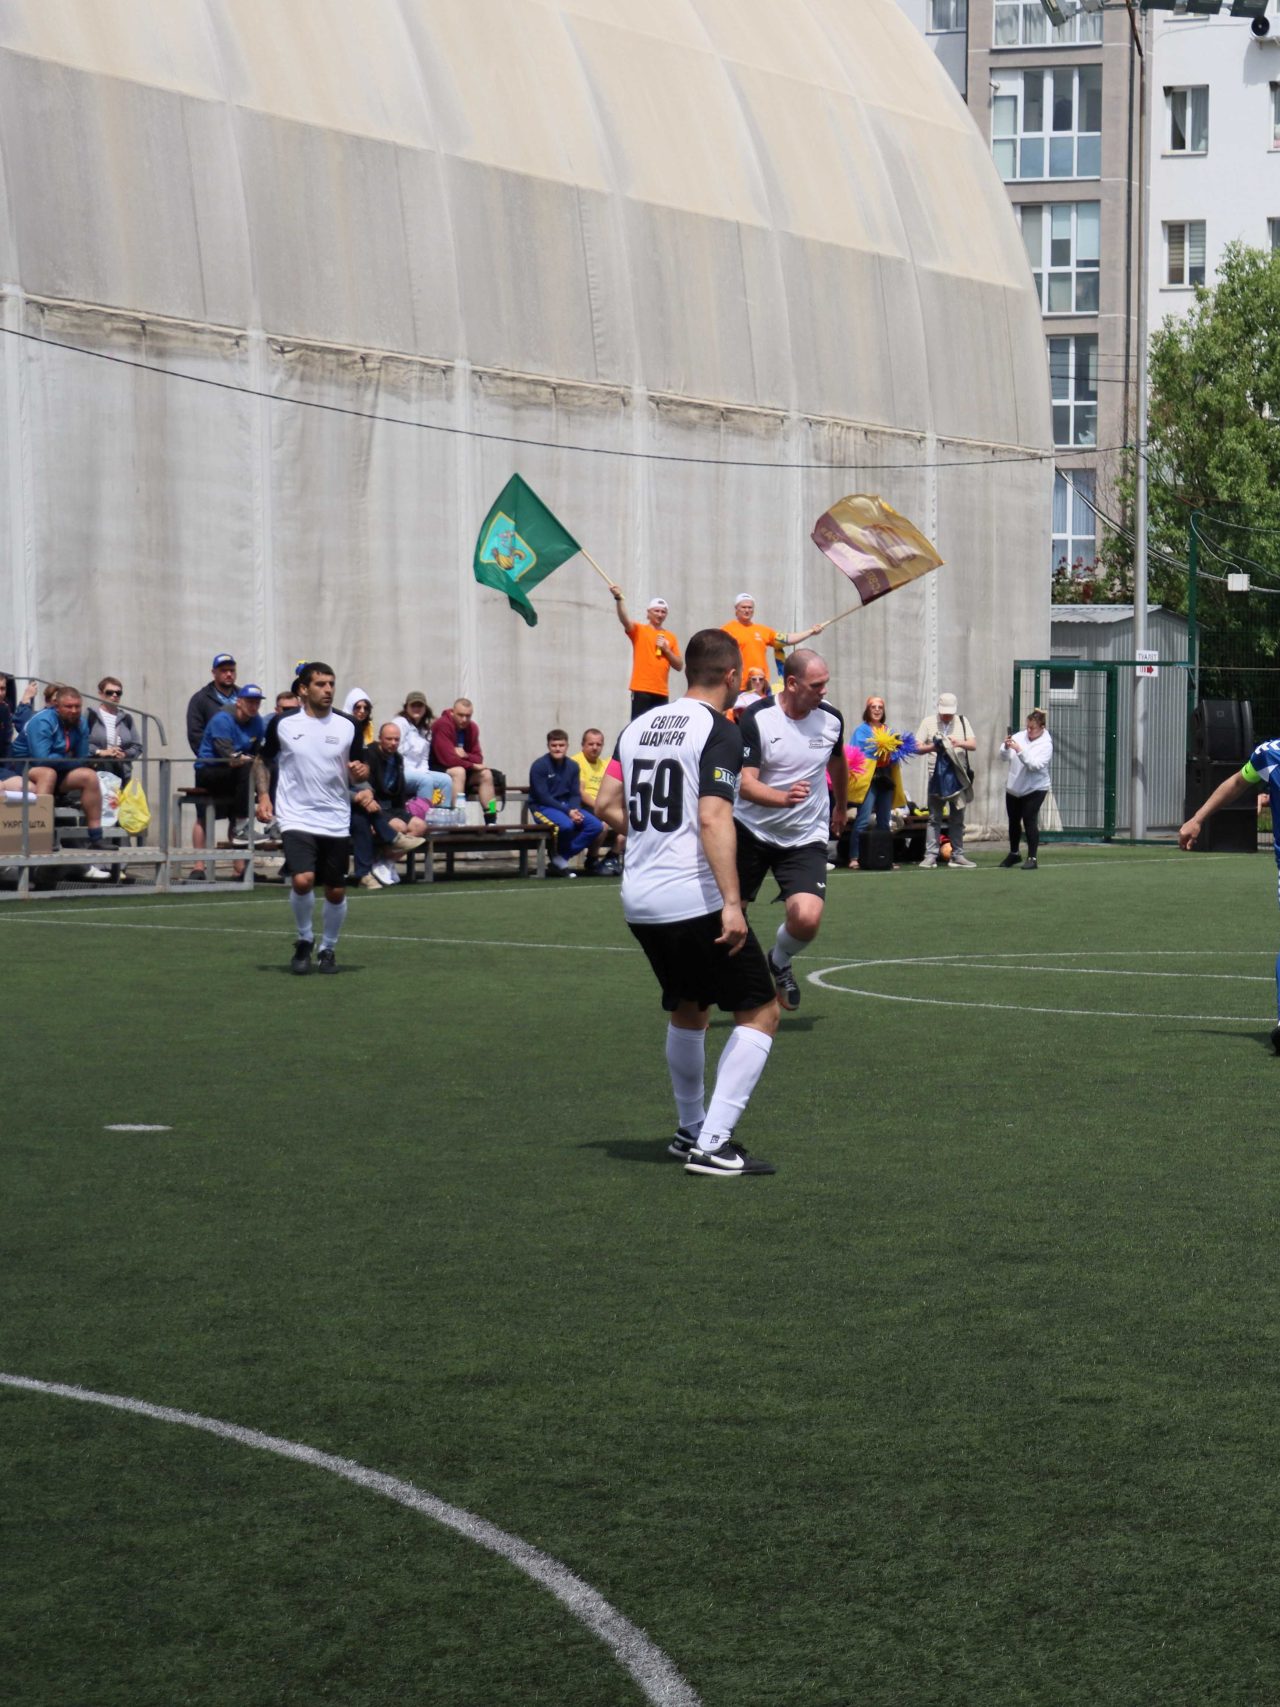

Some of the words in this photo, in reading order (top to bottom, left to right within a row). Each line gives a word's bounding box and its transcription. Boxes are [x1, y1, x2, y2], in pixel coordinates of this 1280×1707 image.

[650, 715, 690, 730] СВІТЛО
[630, 758, 684, 832] 59
[2, 820, 46, 829] УКРПШТА
